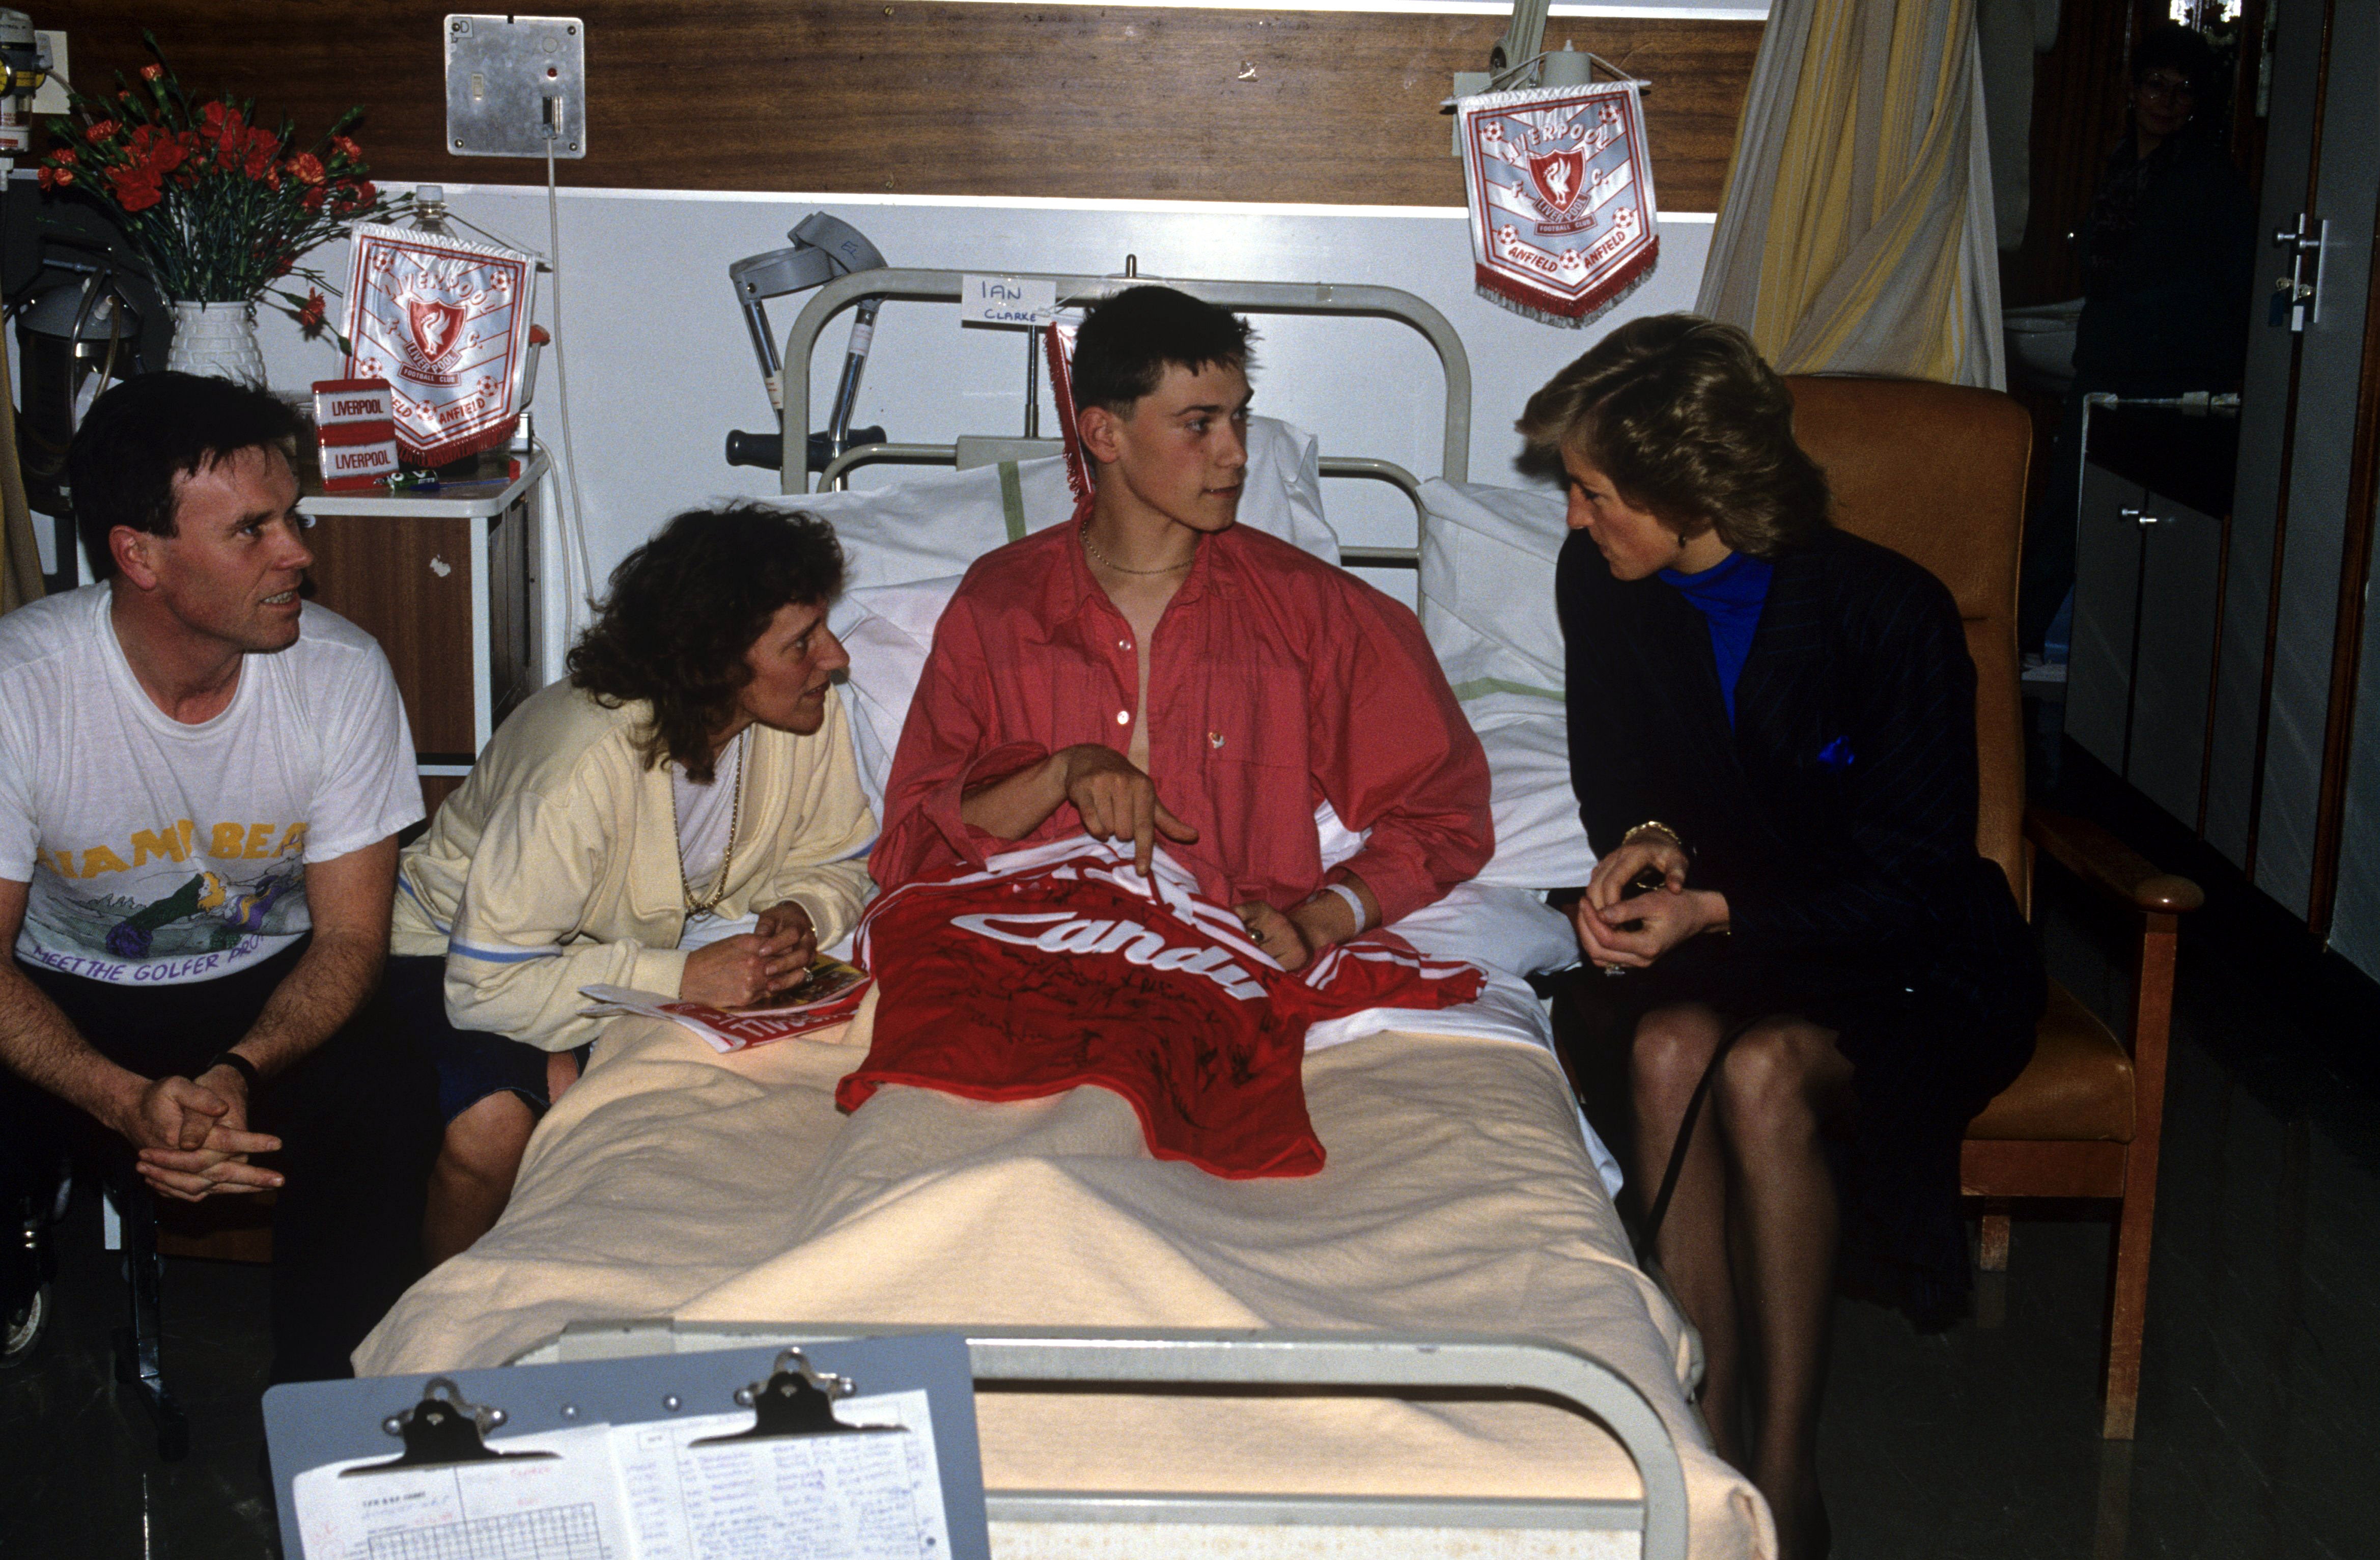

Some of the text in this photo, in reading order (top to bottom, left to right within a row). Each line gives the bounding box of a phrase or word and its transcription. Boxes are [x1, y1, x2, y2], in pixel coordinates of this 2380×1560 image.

[1499, 123, 1610, 165] LIVERPOOL
[1539, 218, 1591, 232] FOOTBALL CLUB
[1508, 246, 1558, 272] ANFIELD
[1583, 231, 1626, 269] ANFIELD
[384, 270, 496, 315] LIVERPOOL
[982, 281, 1021, 299] IAN
[984, 309, 1037, 322] CLARKE
[404, 370, 434, 381] FOOTBALL
[332, 399, 383, 416] LIVERPOOL
[439, 398, 486, 425] ANFIELD
[335, 450, 390, 469] LIVERPOOL
[34, 946, 86, 971] MEET
[86, 960, 126, 981] THE
[134, 953, 219, 981] GOLFER
[950, 911, 1269, 1000] Candy
